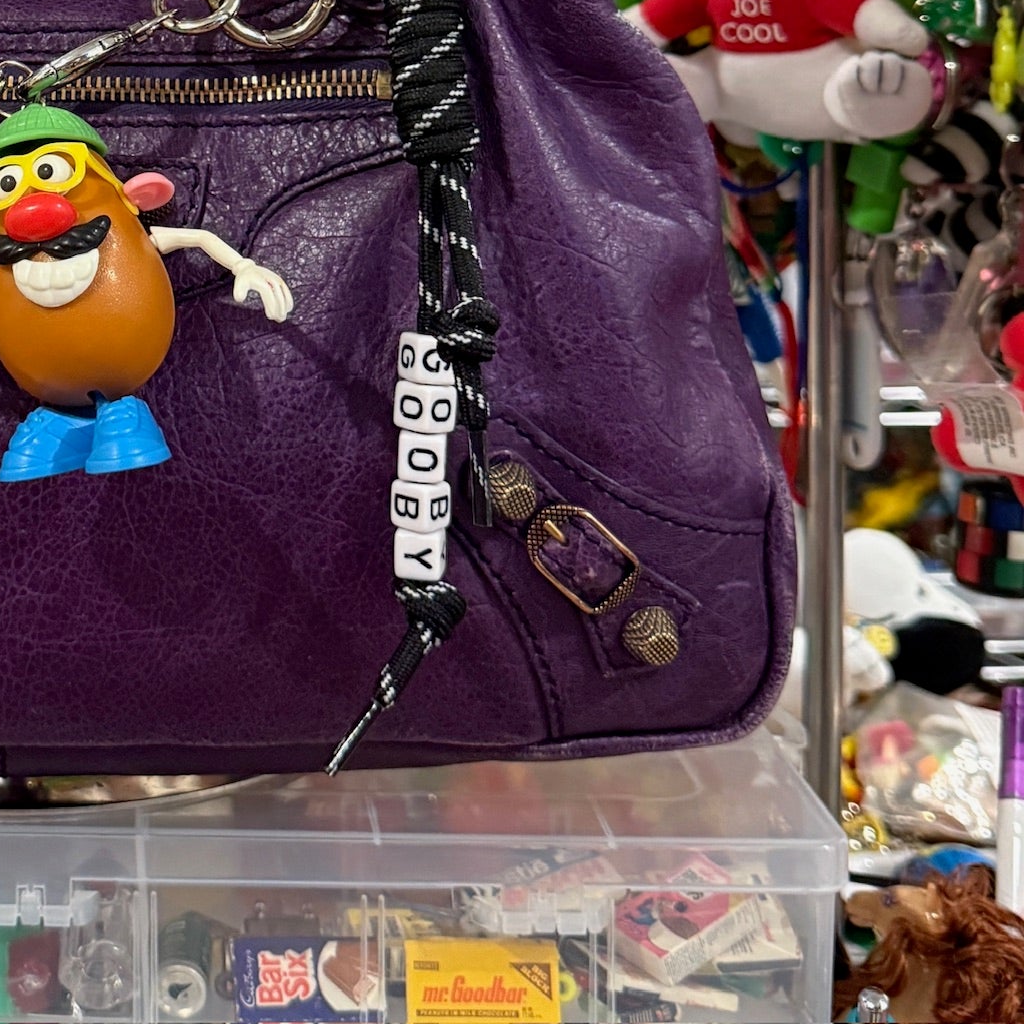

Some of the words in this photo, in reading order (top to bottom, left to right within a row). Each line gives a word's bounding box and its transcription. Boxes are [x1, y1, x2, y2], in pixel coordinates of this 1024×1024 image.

[719, 21, 789, 44] COOL
[257, 952, 284, 1005] Bar
[283, 949, 313, 999] Six
[519, 965, 551, 994] BLOCK
[531, 964, 548, 980] BIG
[422, 985, 448, 1003] mr.
[450, 975, 527, 1004] Goodbar
